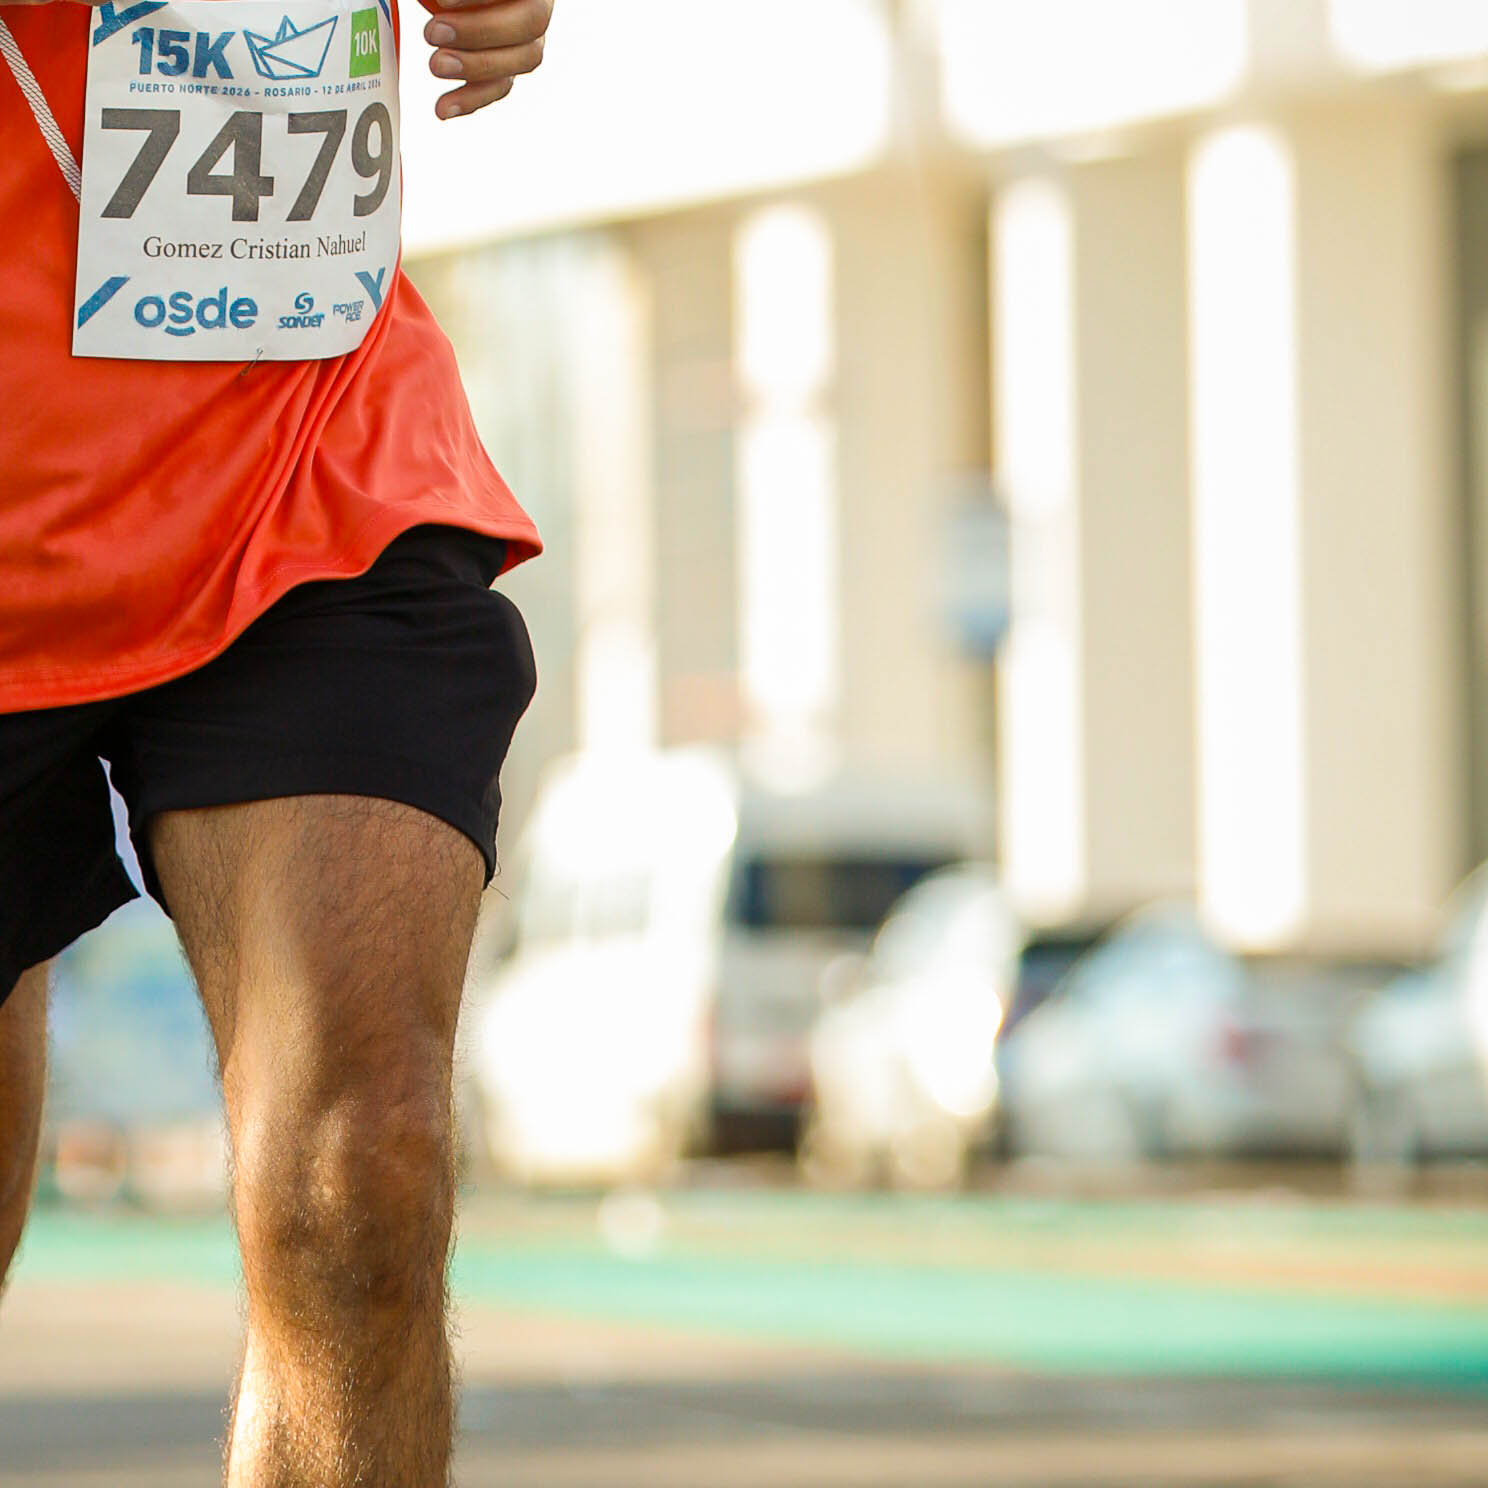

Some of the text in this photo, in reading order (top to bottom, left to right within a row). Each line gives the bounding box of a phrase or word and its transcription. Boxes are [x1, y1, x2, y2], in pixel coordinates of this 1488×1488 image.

[131, 26, 236, 80] 15K
[354, 28, 378, 57] 10K
[129, 82, 175, 94] PUERTO
[179, 84, 218, 95] NORTE
[222, 86, 251, 97] 2026
[264, 87, 311, 97] ROSARIO
[322, 85, 332, 96] 12
[335, 84, 345, 94] DE
[346, 80, 366, 93] ABRIL
[100, 102, 393, 222] 7479
[143, 231, 366, 260] Gomez Cristian Nahuel
[134, 286, 258, 331] osde
